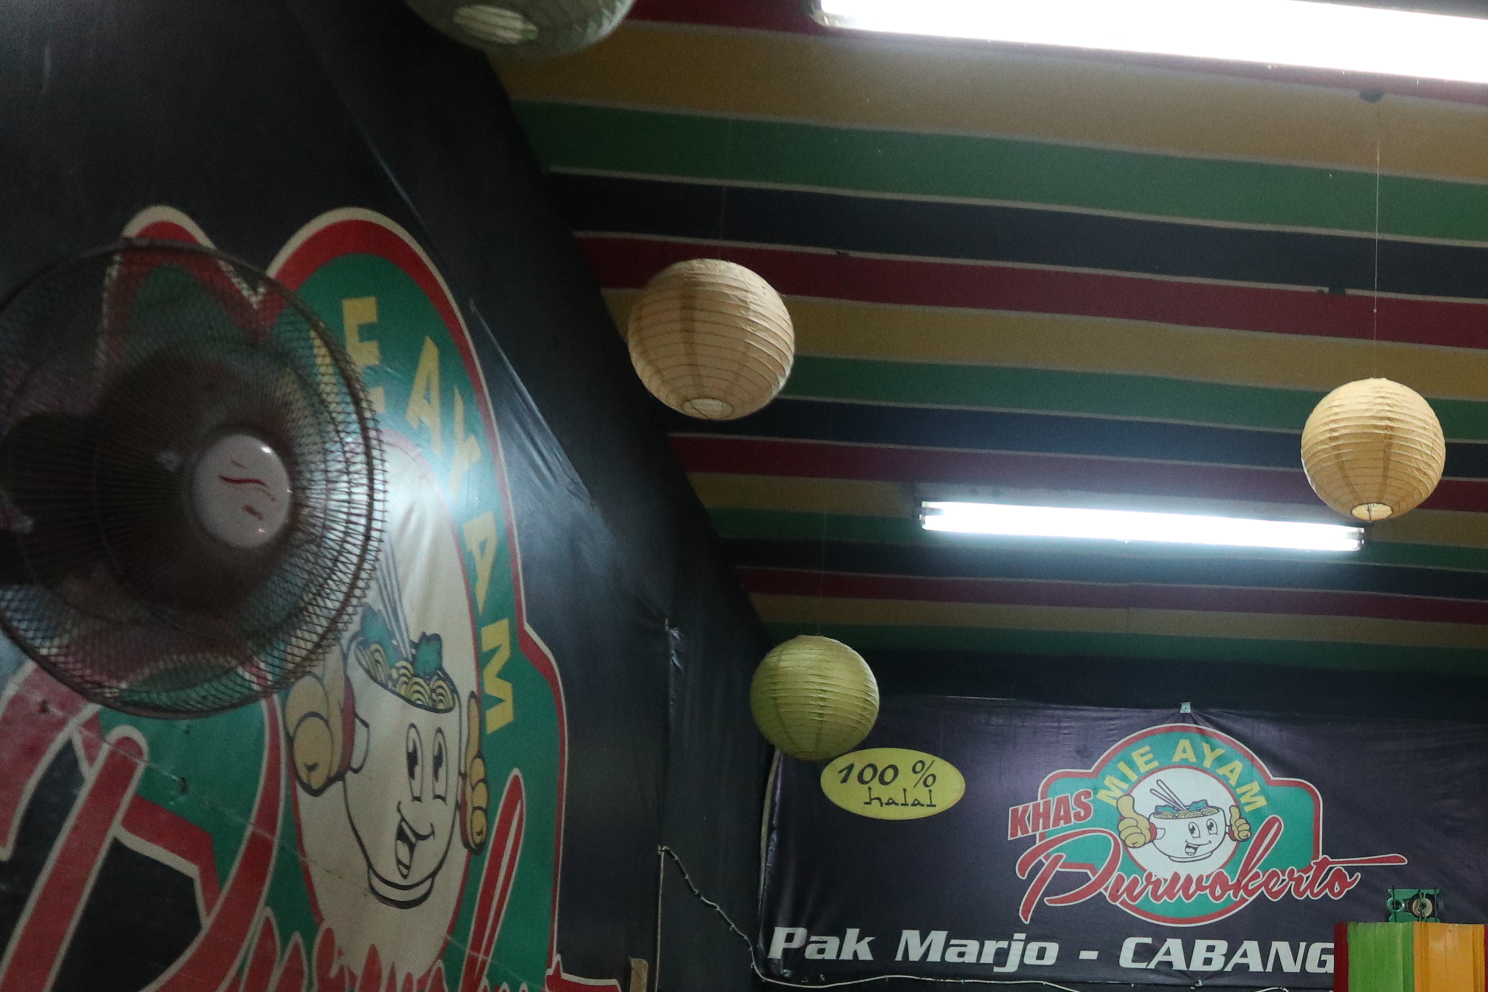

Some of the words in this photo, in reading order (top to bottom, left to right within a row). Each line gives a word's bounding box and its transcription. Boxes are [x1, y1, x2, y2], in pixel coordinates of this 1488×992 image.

[405, 335, 515, 736] AYAM
[837, 762, 900, 787] 100
[911, 758, 938, 789] %
[864, 786, 937, 807] halal
[1096, 744, 1160, 807] MIE
[1171, 738, 1268, 813] AYAM
[1007, 788, 1094, 841] KHAS
[1015, 814, 1409, 925] Purwokerto
[765, 926, 877, 962] Pak
[893, 929, 1061, 973] Marjo
[1078, 949, 1100, 961] -
[1117, 936, 1335, 974] CABANG
